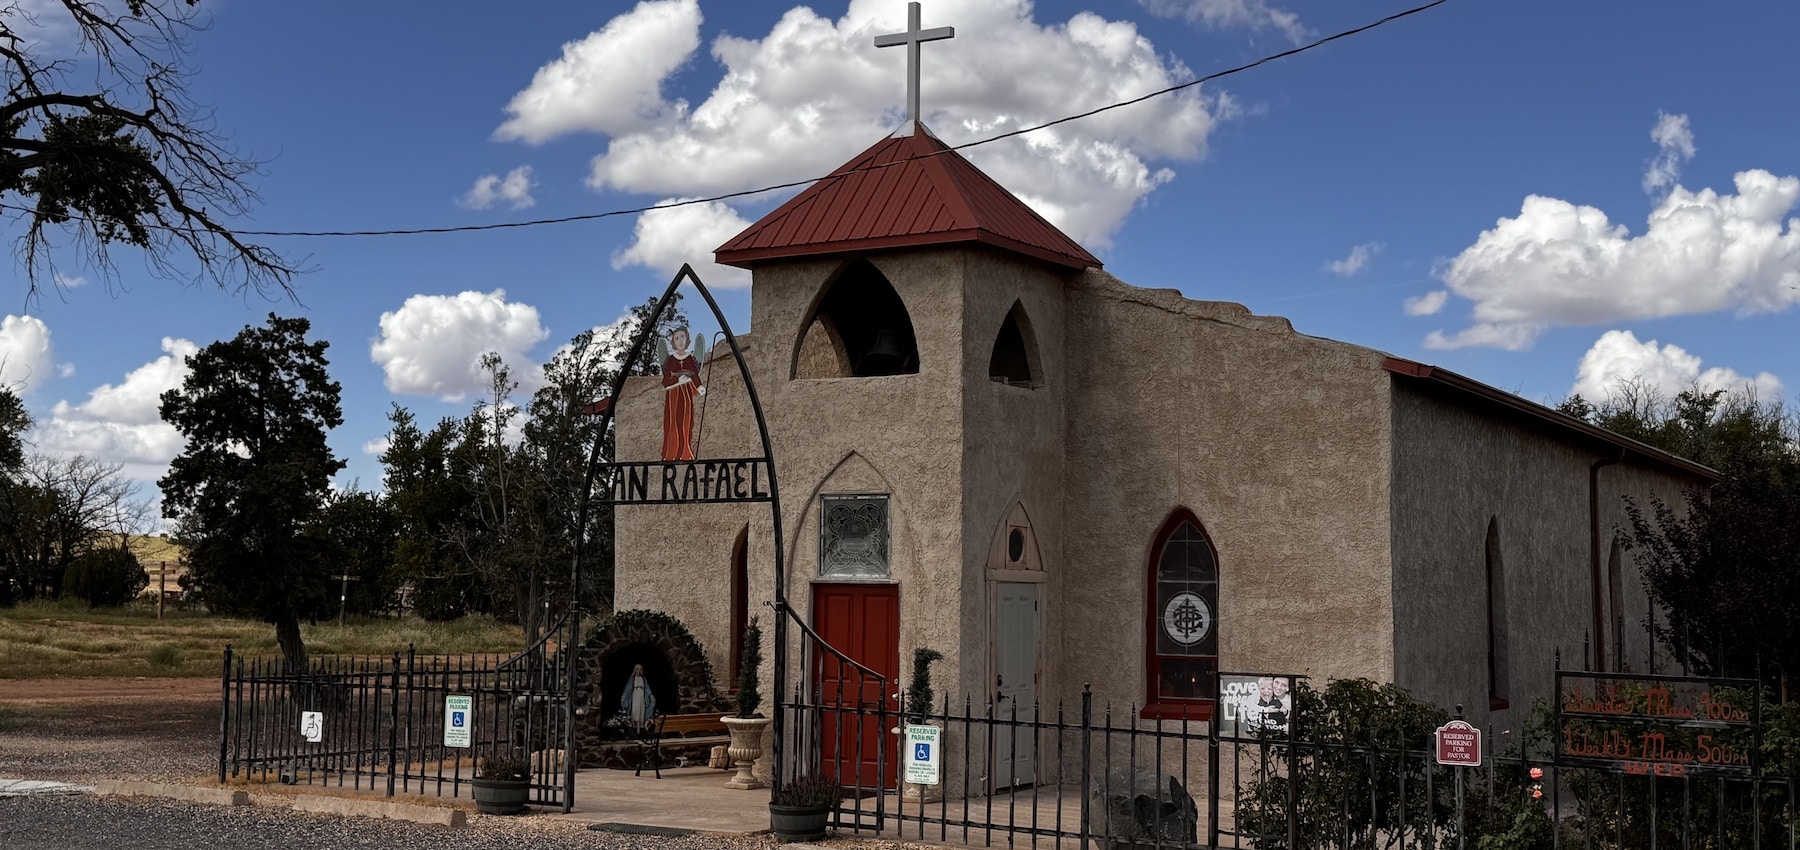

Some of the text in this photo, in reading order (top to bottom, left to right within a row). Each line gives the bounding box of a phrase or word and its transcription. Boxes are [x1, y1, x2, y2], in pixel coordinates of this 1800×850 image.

[661, 462, 768, 501] RAFAEL
[1220, 679, 1258, 694] Love
[1565, 686, 1634, 715] Sunday
[1639, 687, 1694, 718] Mass
[909, 727, 937, 735] RESERVED
[911, 734, 935, 742] PARKING
[1445, 739, 1472, 747] PARKING
[1562, 727, 1631, 758] Weekly
[1637, 730, 1694, 762] Mass
[1447, 752, 1471, 760] PASTOR
[1625, 761, 1685, 778] WED
